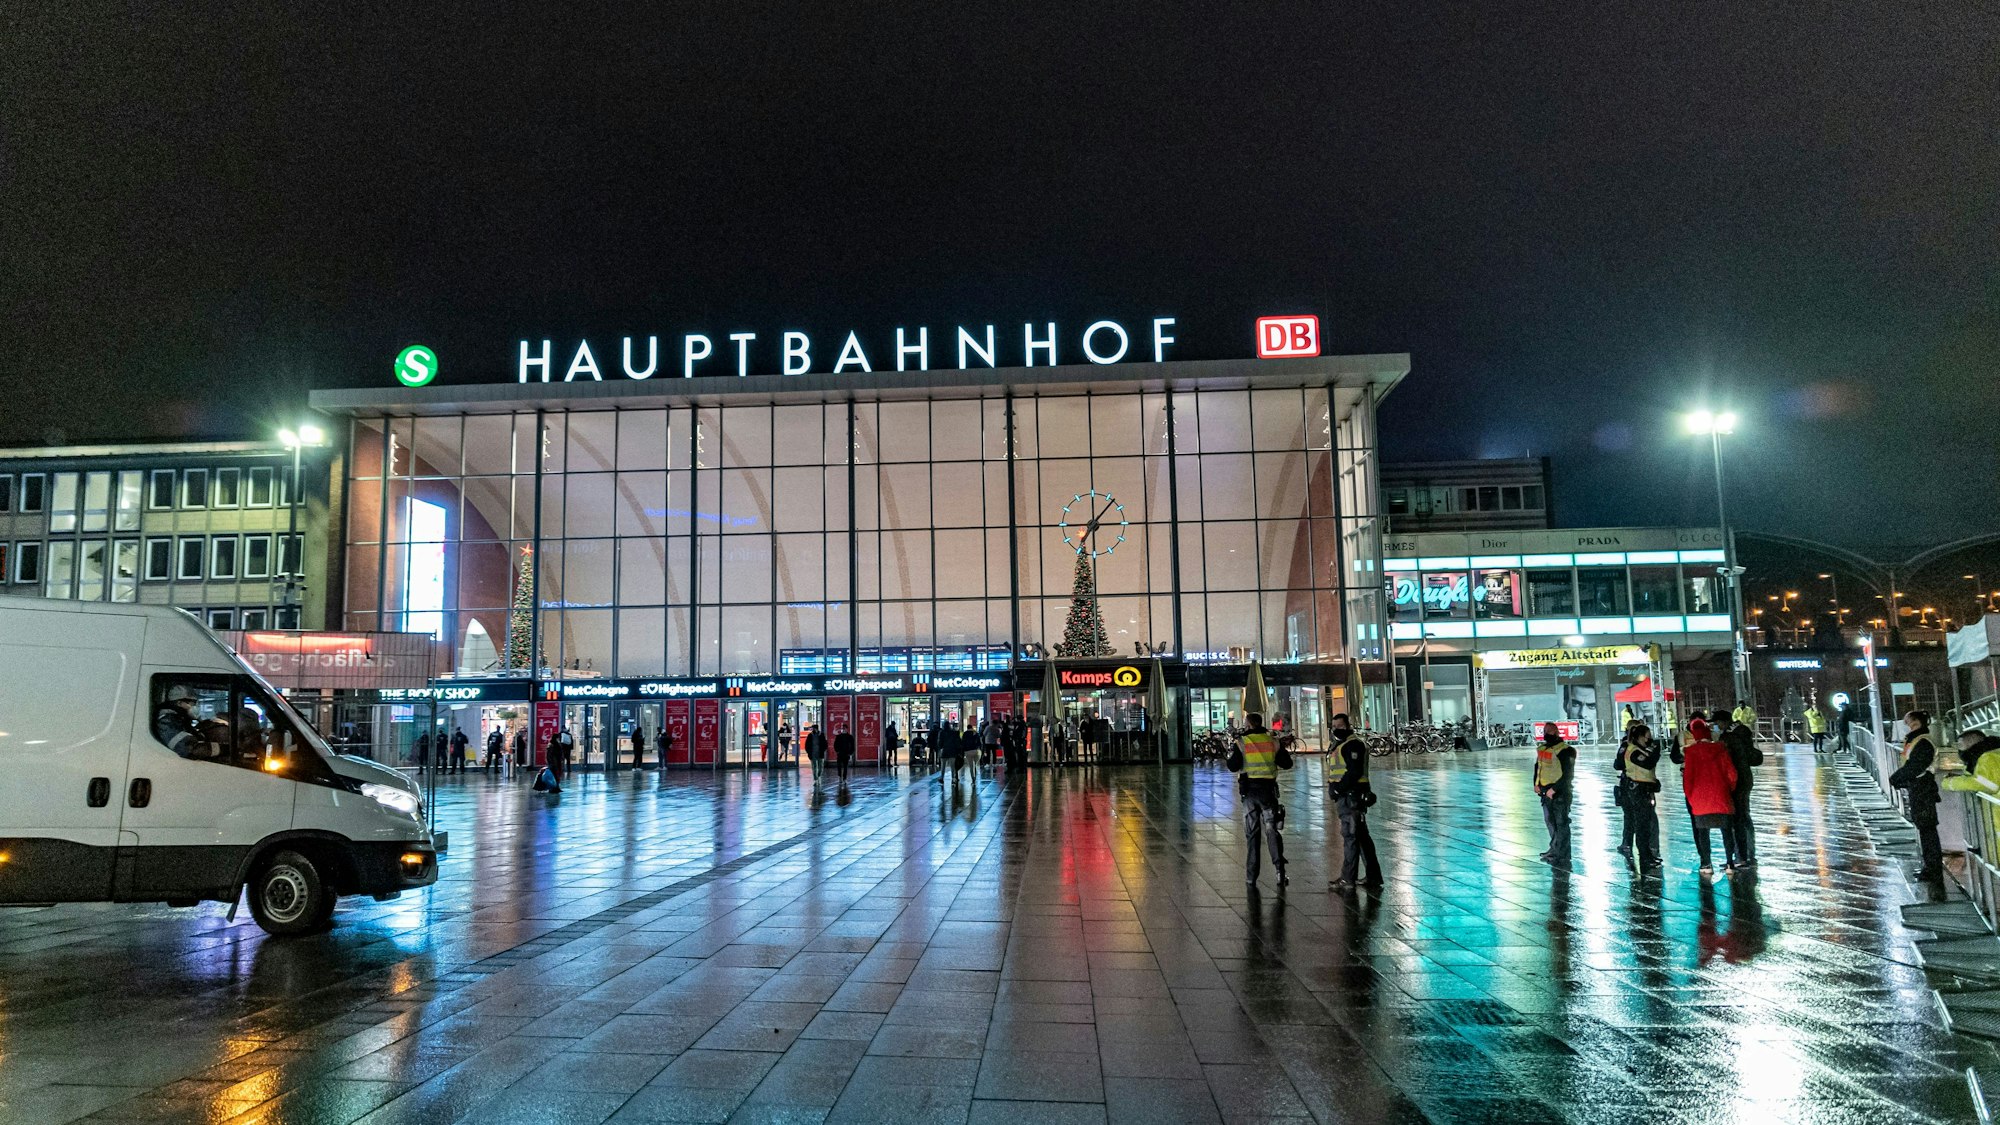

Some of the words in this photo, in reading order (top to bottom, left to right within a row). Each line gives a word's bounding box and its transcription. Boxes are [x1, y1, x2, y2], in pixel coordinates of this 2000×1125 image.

[1265, 323, 1312, 351] DB
[518, 317, 1176, 384] HAUPTBAHNHOF
[400, 349, 431, 383] S
[1482, 538, 1508, 549] Dior
[1578, 536, 1621, 546] PRADA
[1680, 533, 1722, 543] GUCC
[1394, 576, 1488, 610] Douglas
[1509, 652, 1558, 663] Zugang
[1561, 649, 1619, 661] Altstadt
[746, 680, 813, 694] NetCologne
[843, 678, 903, 692] Highspeed
[933, 676, 1000, 691] NetCologne
[1061, 671, 1113, 686] Kamps
[379, 688, 405, 700] THE
[445, 687, 480, 699] SHOP
[563, 685, 629, 698] NetCologne
[658, 683, 717, 696] Highspeed
